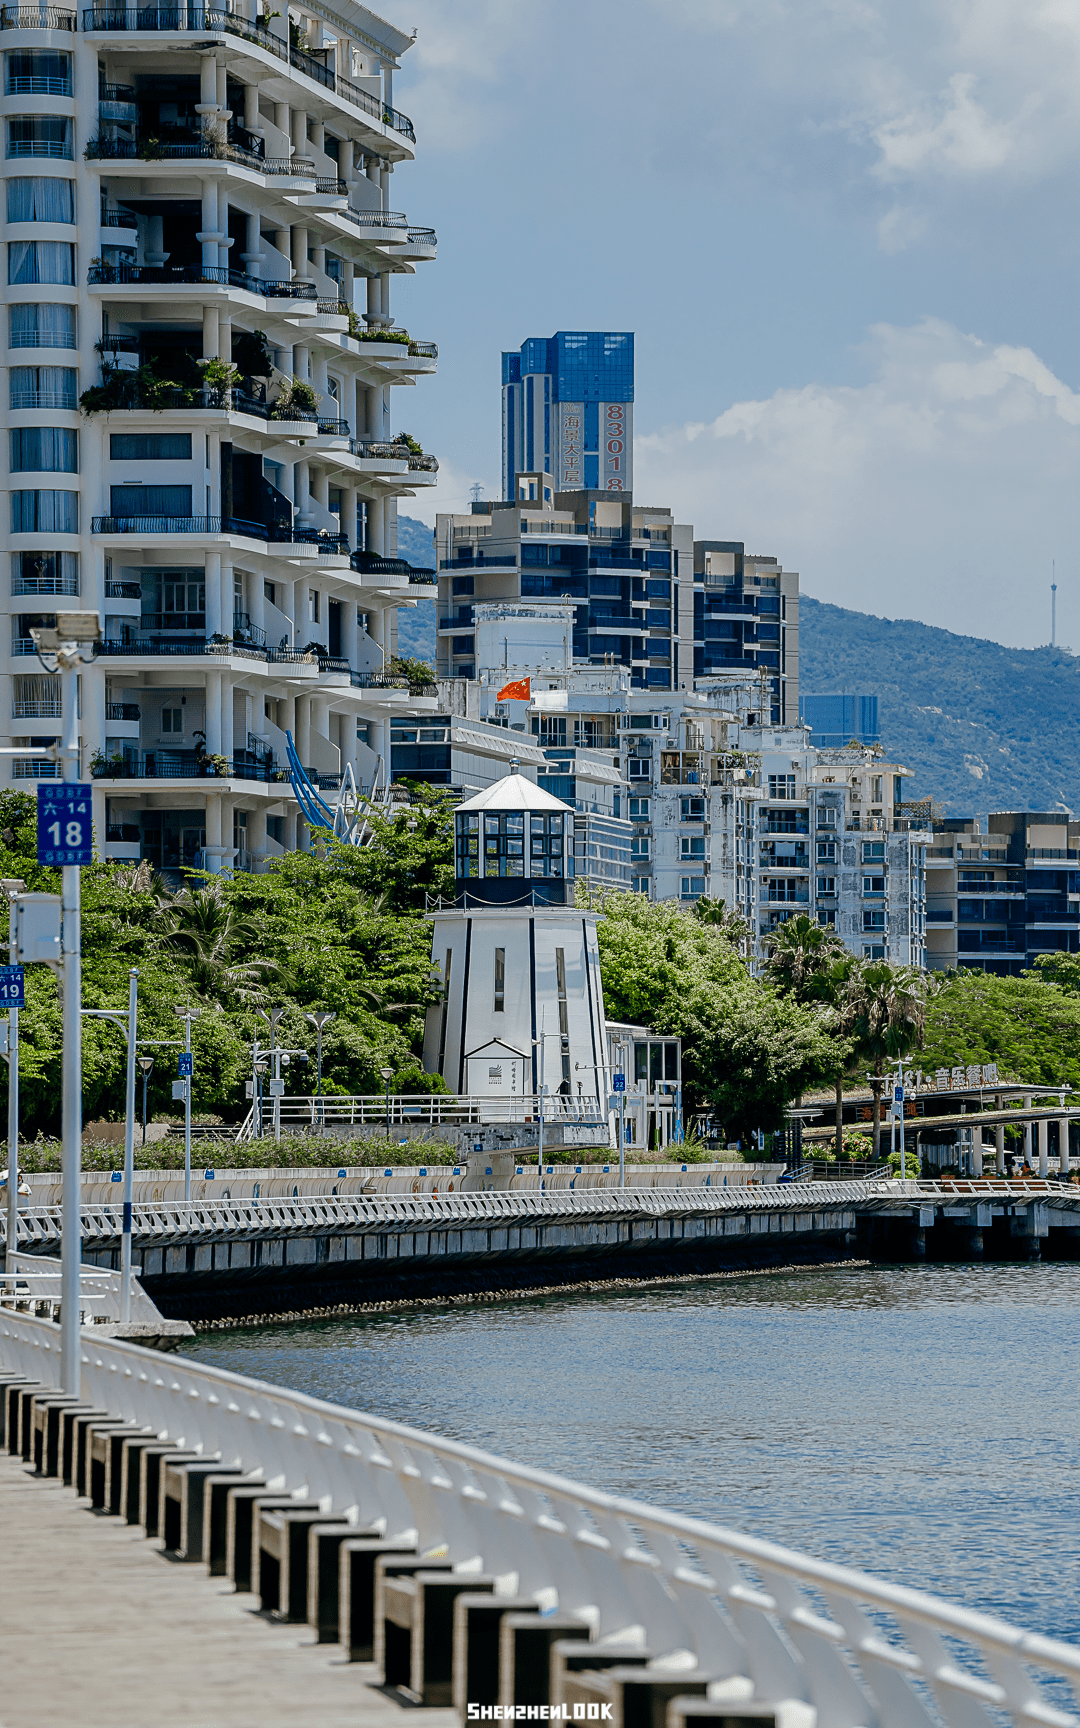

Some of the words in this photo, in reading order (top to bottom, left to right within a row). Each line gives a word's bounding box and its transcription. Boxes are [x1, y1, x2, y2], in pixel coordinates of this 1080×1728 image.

[564, 416, 580, 482] 海景大平层
[607, 405, 624, 491] 83018
[47, 821, 82, 847] 18
[1, 984, 20, 997] 19
